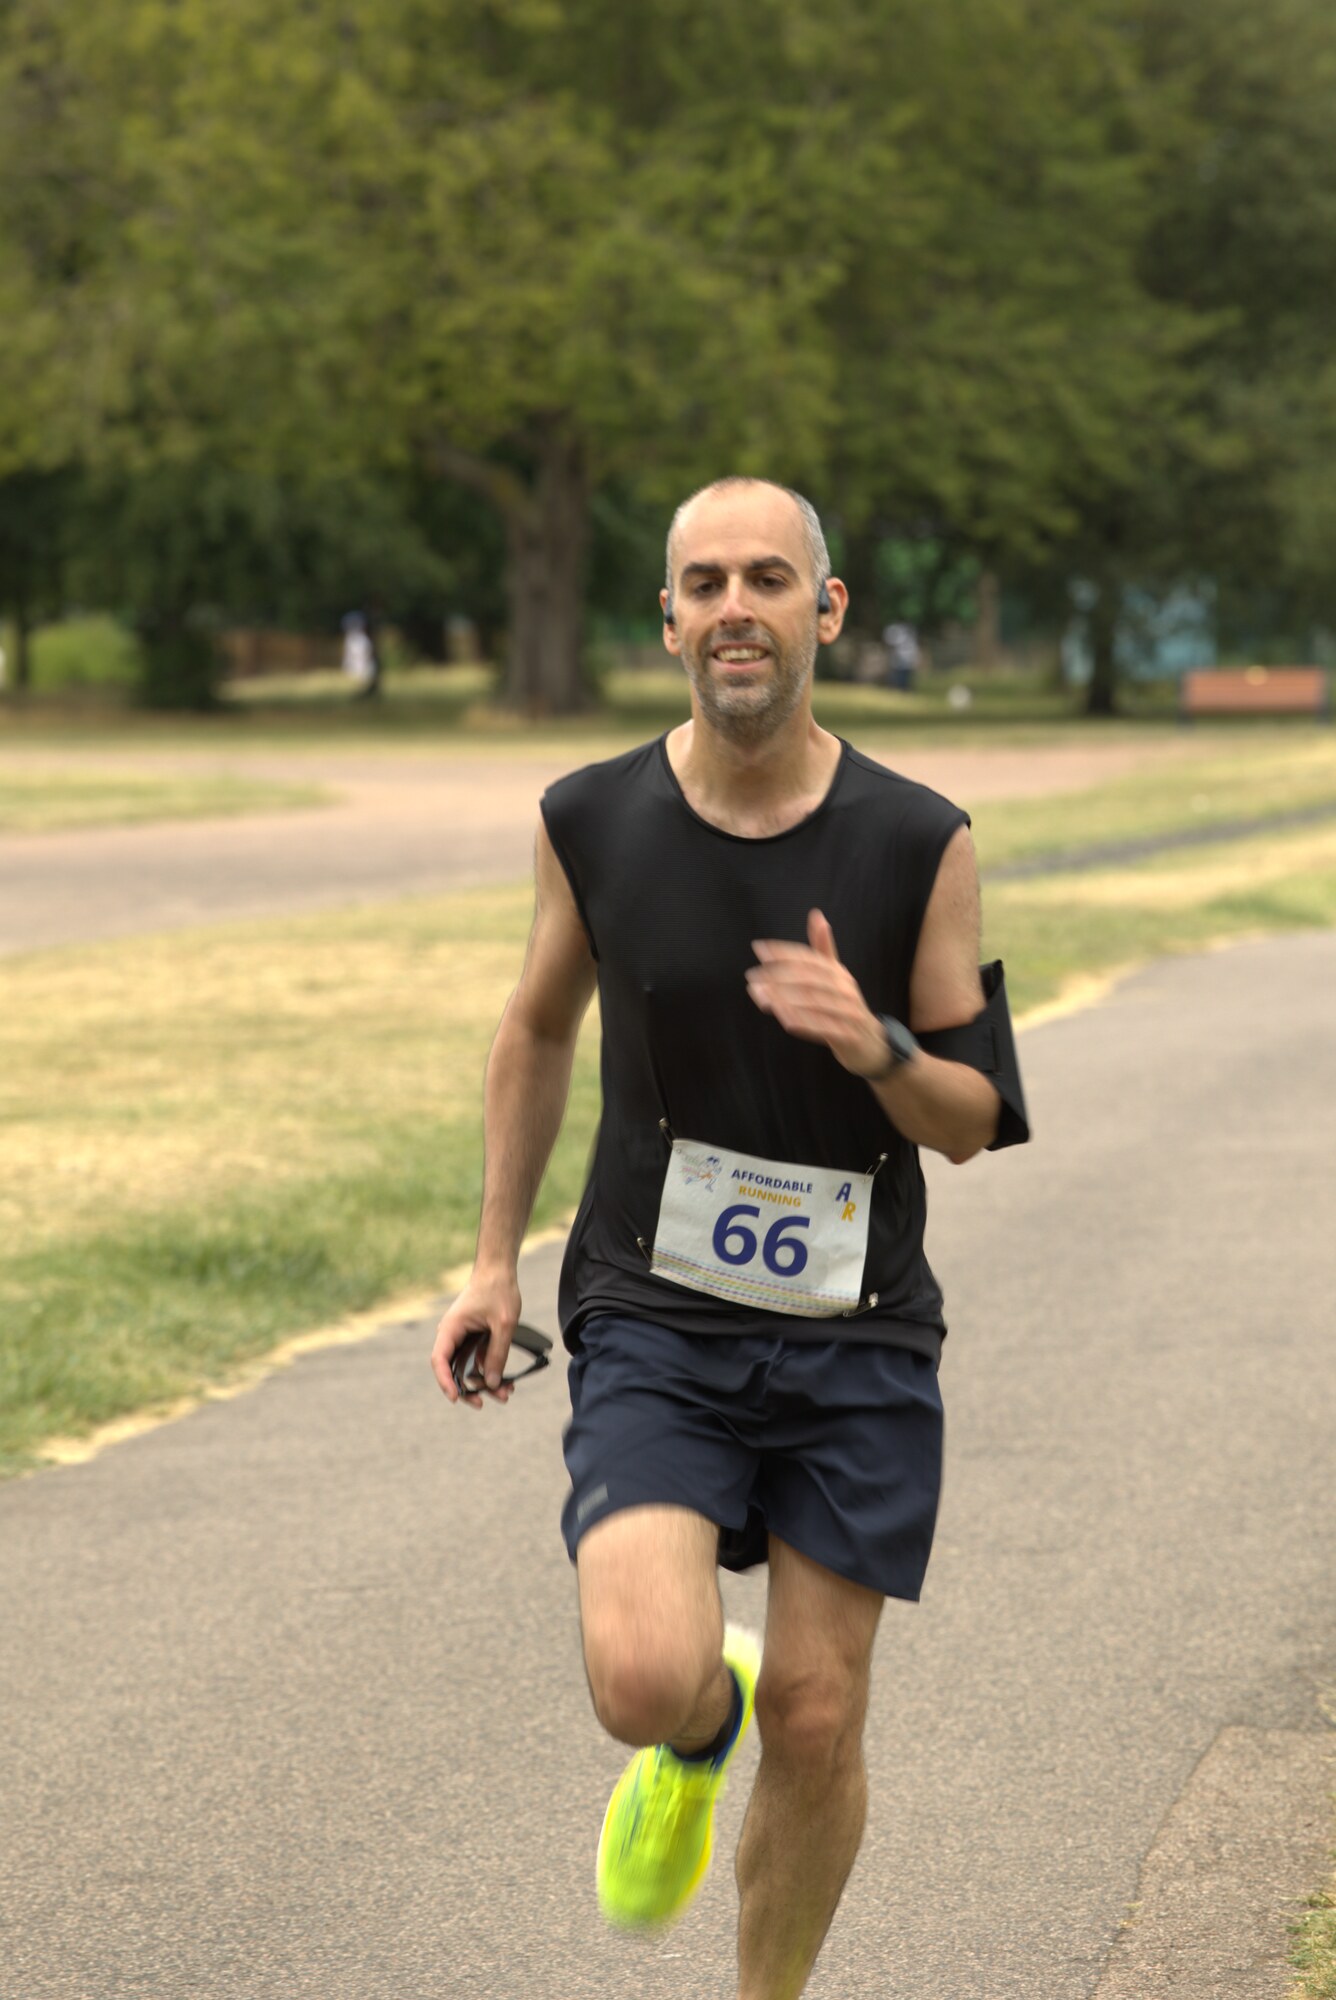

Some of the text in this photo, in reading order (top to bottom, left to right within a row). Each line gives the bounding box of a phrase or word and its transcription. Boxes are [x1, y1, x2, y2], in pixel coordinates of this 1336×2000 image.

[731, 1168, 813, 1194] AFFORDABLE
[738, 1185, 802, 1207] RUNNING
[712, 1203, 811, 1278] 66
